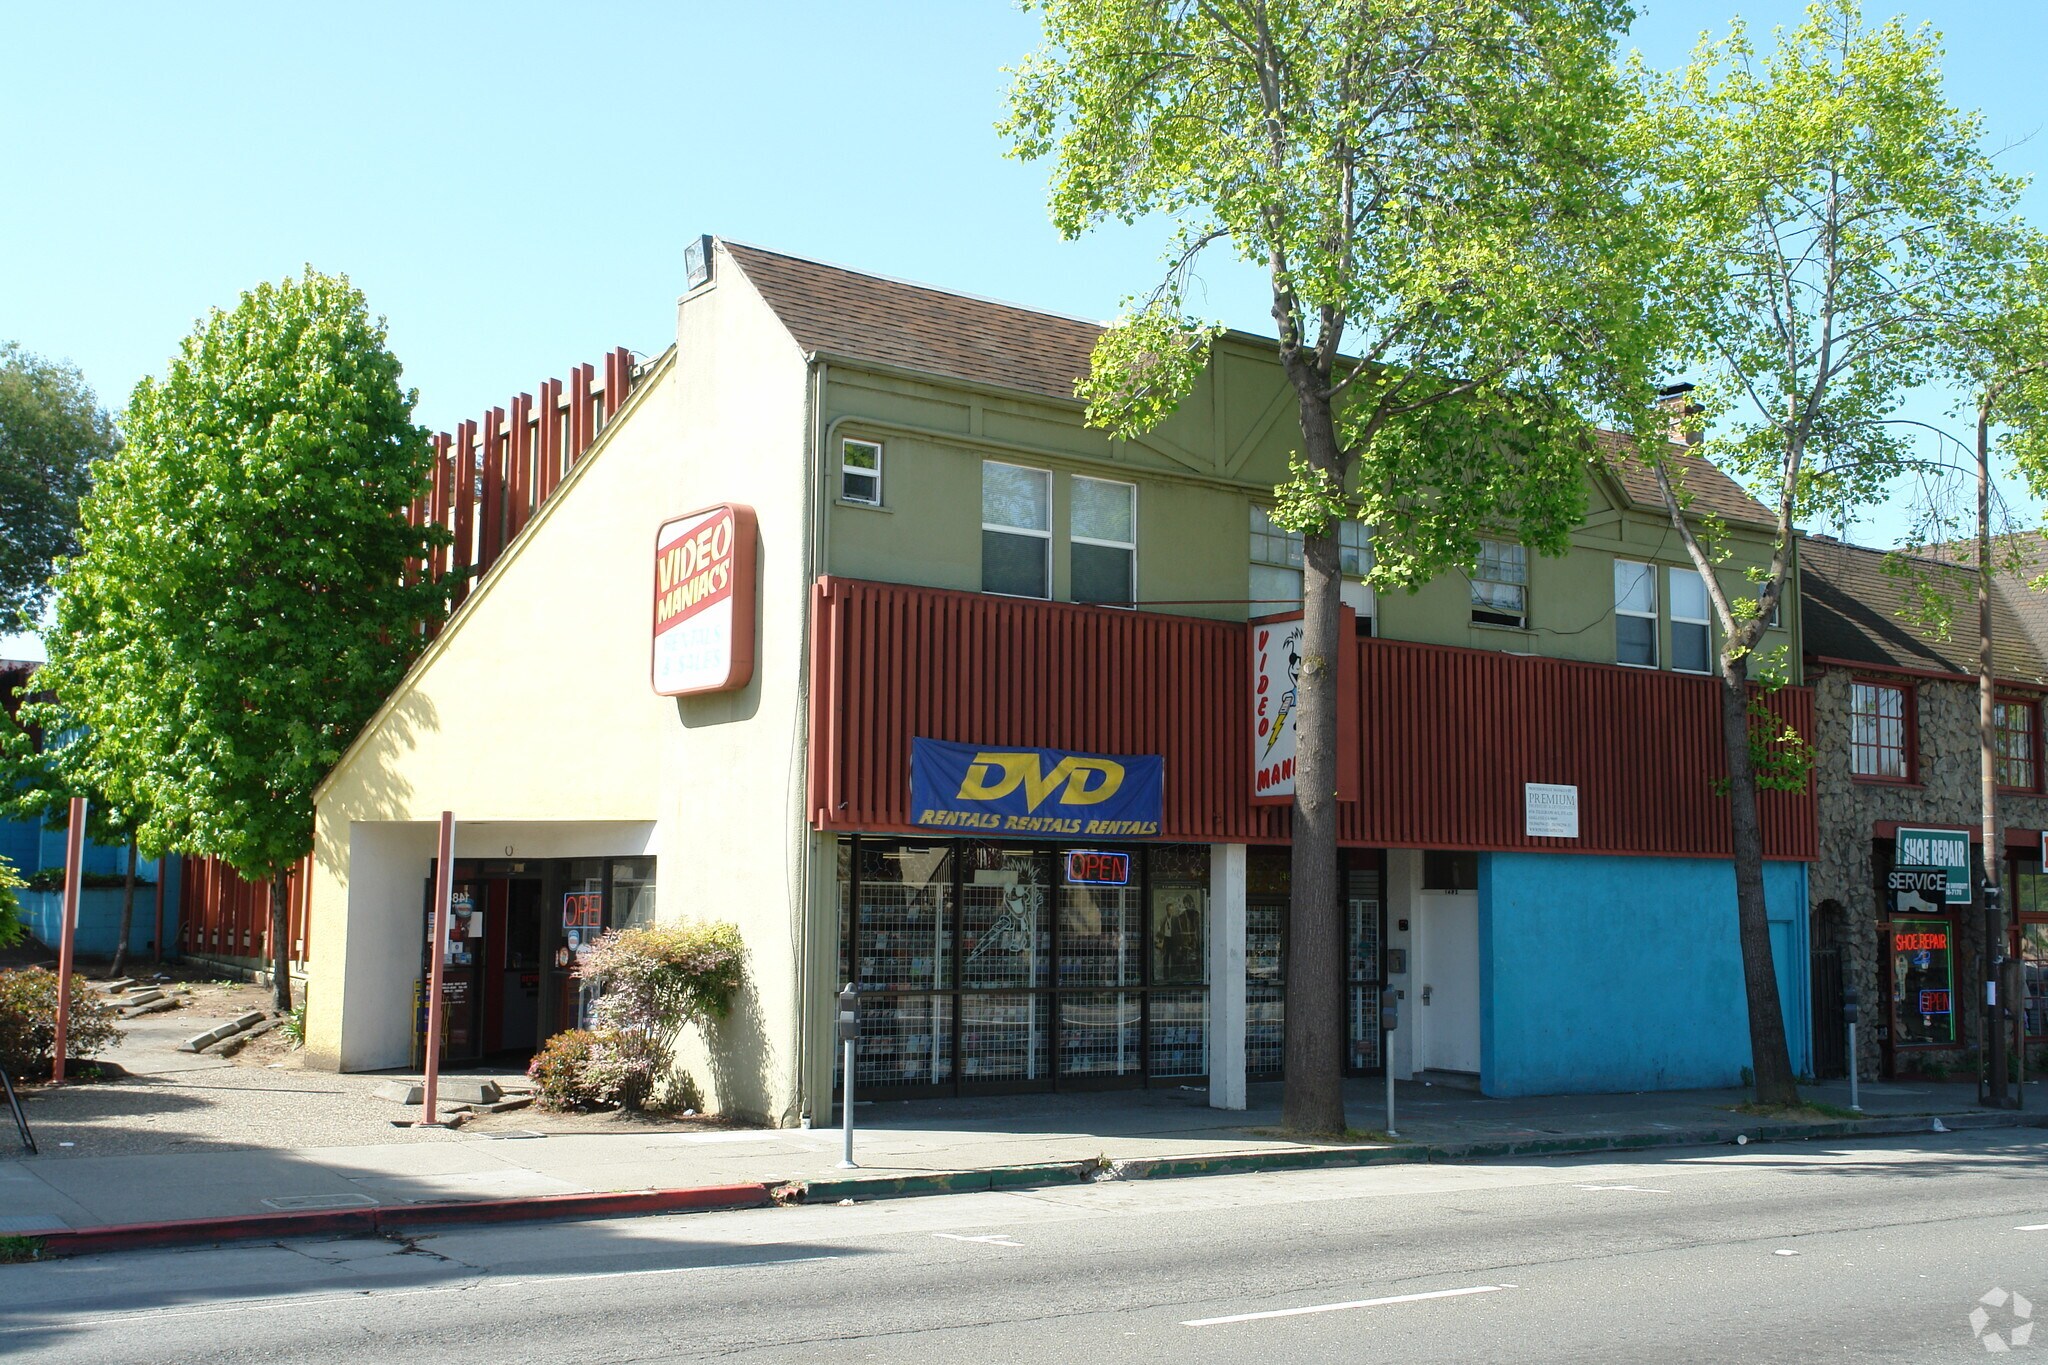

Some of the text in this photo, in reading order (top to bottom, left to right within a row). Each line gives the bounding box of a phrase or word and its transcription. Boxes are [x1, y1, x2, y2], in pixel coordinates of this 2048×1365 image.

[659, 515, 733, 593] VIDEO
[657, 557, 731, 625] MANIACS
[1256, 630, 1270, 738] VIDEO
[955, 751, 1126, 815] DVD
[1528, 792, 1576, 806] PREMIUM
[918, 809, 1159, 835] RENTALS RENTALS RENTALS
[1070, 852, 1127, 882] OPEN
[1903, 838, 1966, 867] SHOE REPAIR
[1887, 872, 1947, 891] SERVICE
[565, 895, 602, 926] OPE
[1896, 934, 1947, 950] SHOE REPAIR
[1922, 992, 1948, 1011] OPEN
